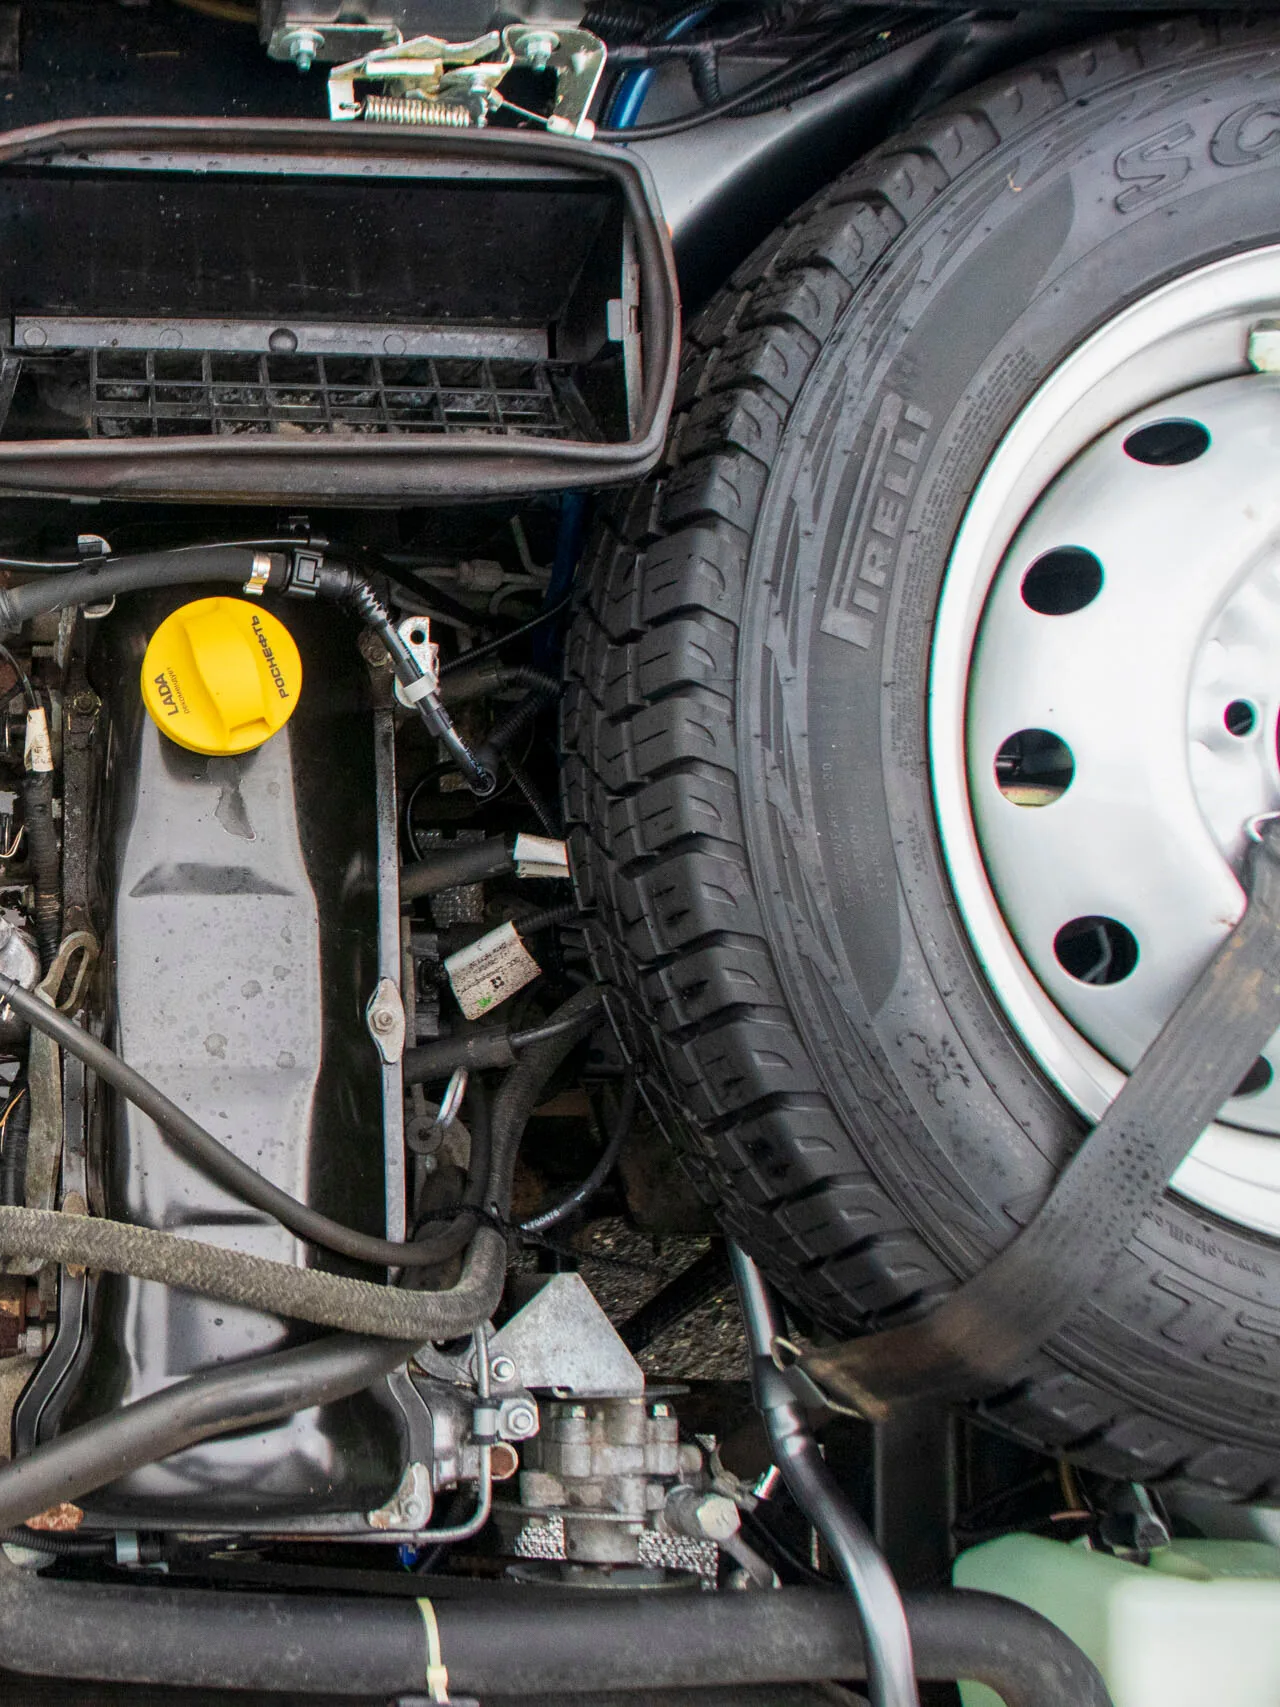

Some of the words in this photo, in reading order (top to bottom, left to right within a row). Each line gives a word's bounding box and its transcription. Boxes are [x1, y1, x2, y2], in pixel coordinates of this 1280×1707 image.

[821, 387, 934, 650] PIRELLI
[166, 665, 193, 715] рекомендует
[251, 614, 289, 699] РОСНЕФТЬ
[154, 672, 179, 716] LADA
